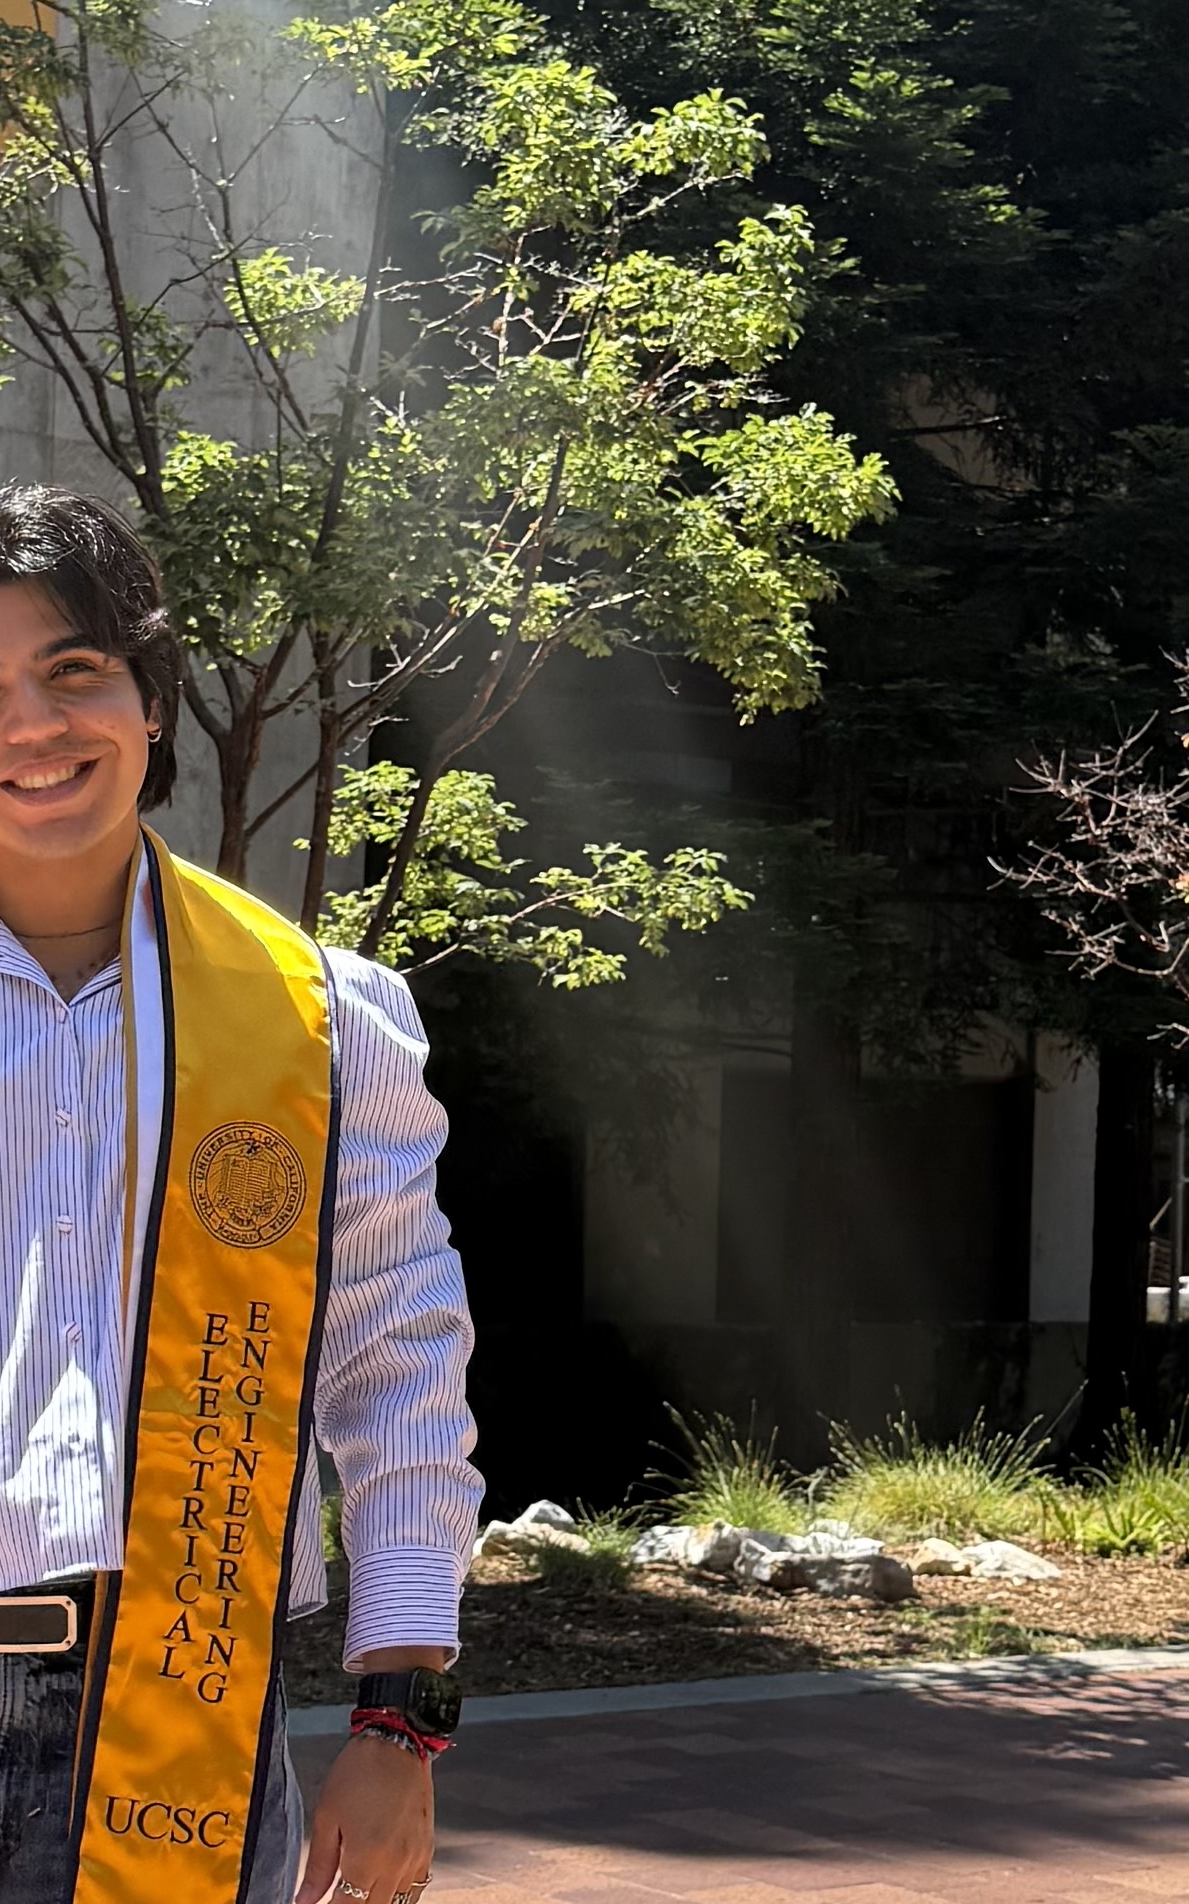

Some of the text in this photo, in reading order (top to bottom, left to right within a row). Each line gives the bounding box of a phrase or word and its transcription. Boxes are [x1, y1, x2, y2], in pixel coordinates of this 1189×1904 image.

[196, 1129, 254, 1181] UNIVERSITY
[269, 1154, 300, 1231] CALIFORNIA
[157, 1312, 230, 1680] ELECTRICAL
[197, 1300, 272, 1704] ENGINEERING
[105, 1795, 230, 1849] UCSC
